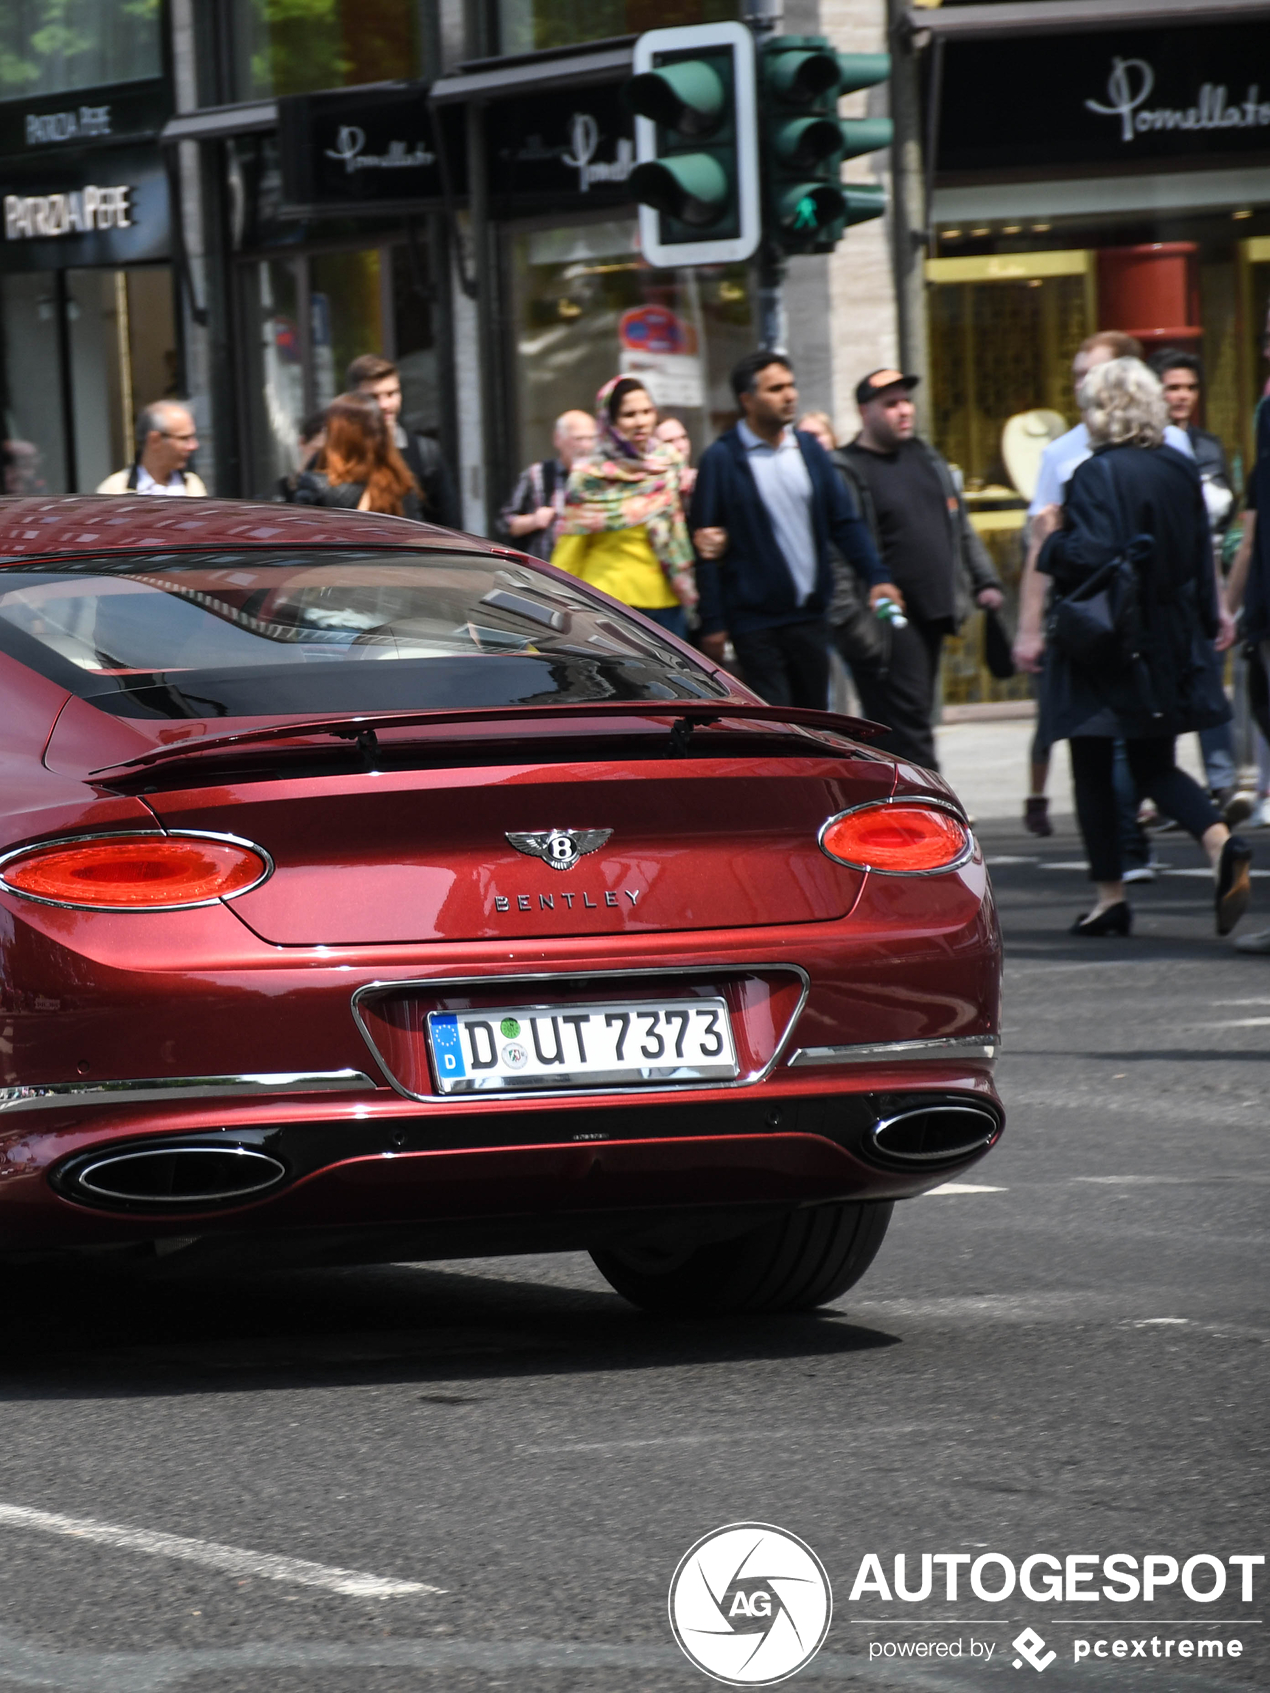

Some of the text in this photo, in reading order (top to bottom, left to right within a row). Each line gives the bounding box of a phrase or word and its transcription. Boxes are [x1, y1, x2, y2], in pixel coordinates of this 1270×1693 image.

[1085, 56, 1270, 141] Pomellato
[4, 184, 131, 240] PATRIZIA PEPE
[551, 836, 573, 859] B
[495, 889, 640, 913] BENTLEY
[465, 1009, 724, 1070] D UT 7373
[445, 1054, 457, 1070] D
